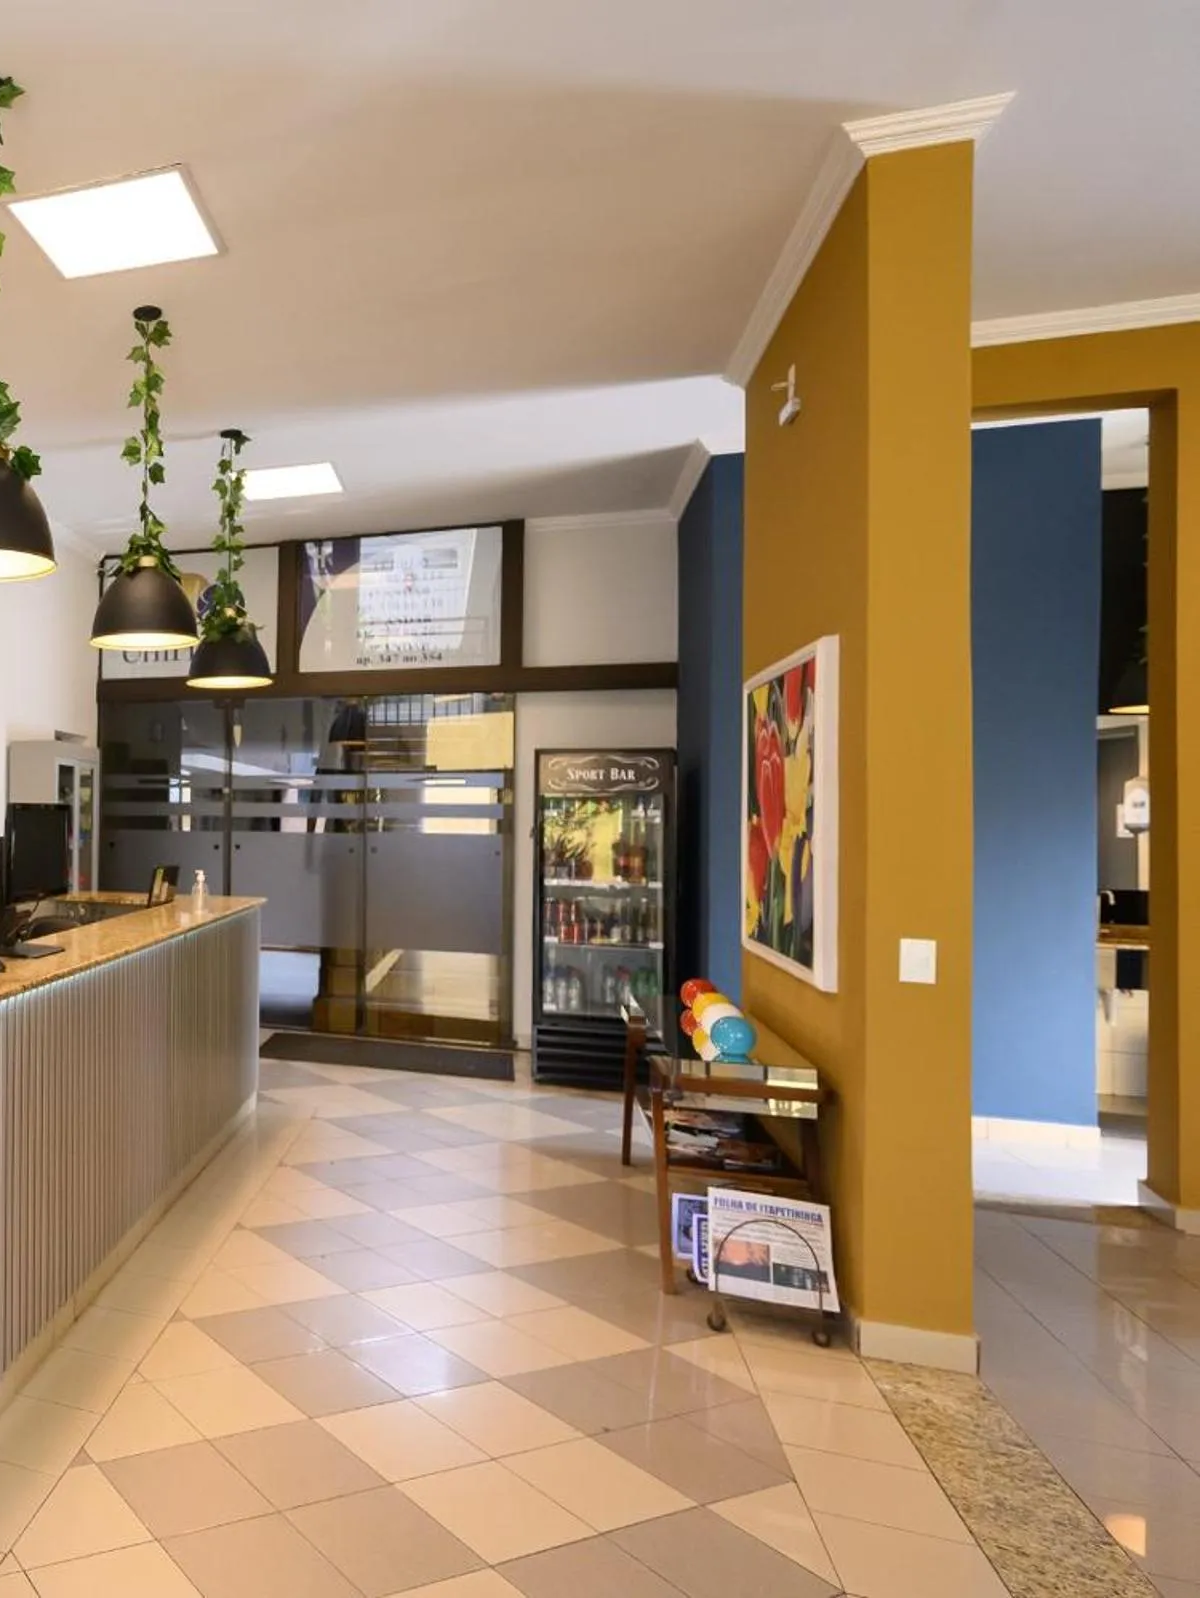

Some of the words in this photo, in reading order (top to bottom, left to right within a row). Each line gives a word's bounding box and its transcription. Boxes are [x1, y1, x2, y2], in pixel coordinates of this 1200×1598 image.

[567, 767, 605, 780] SPORT
[610, 767, 636, 780] BAR
[714, 1196, 744, 1211] FOLHA
[745, 1202, 758, 1212] DE
